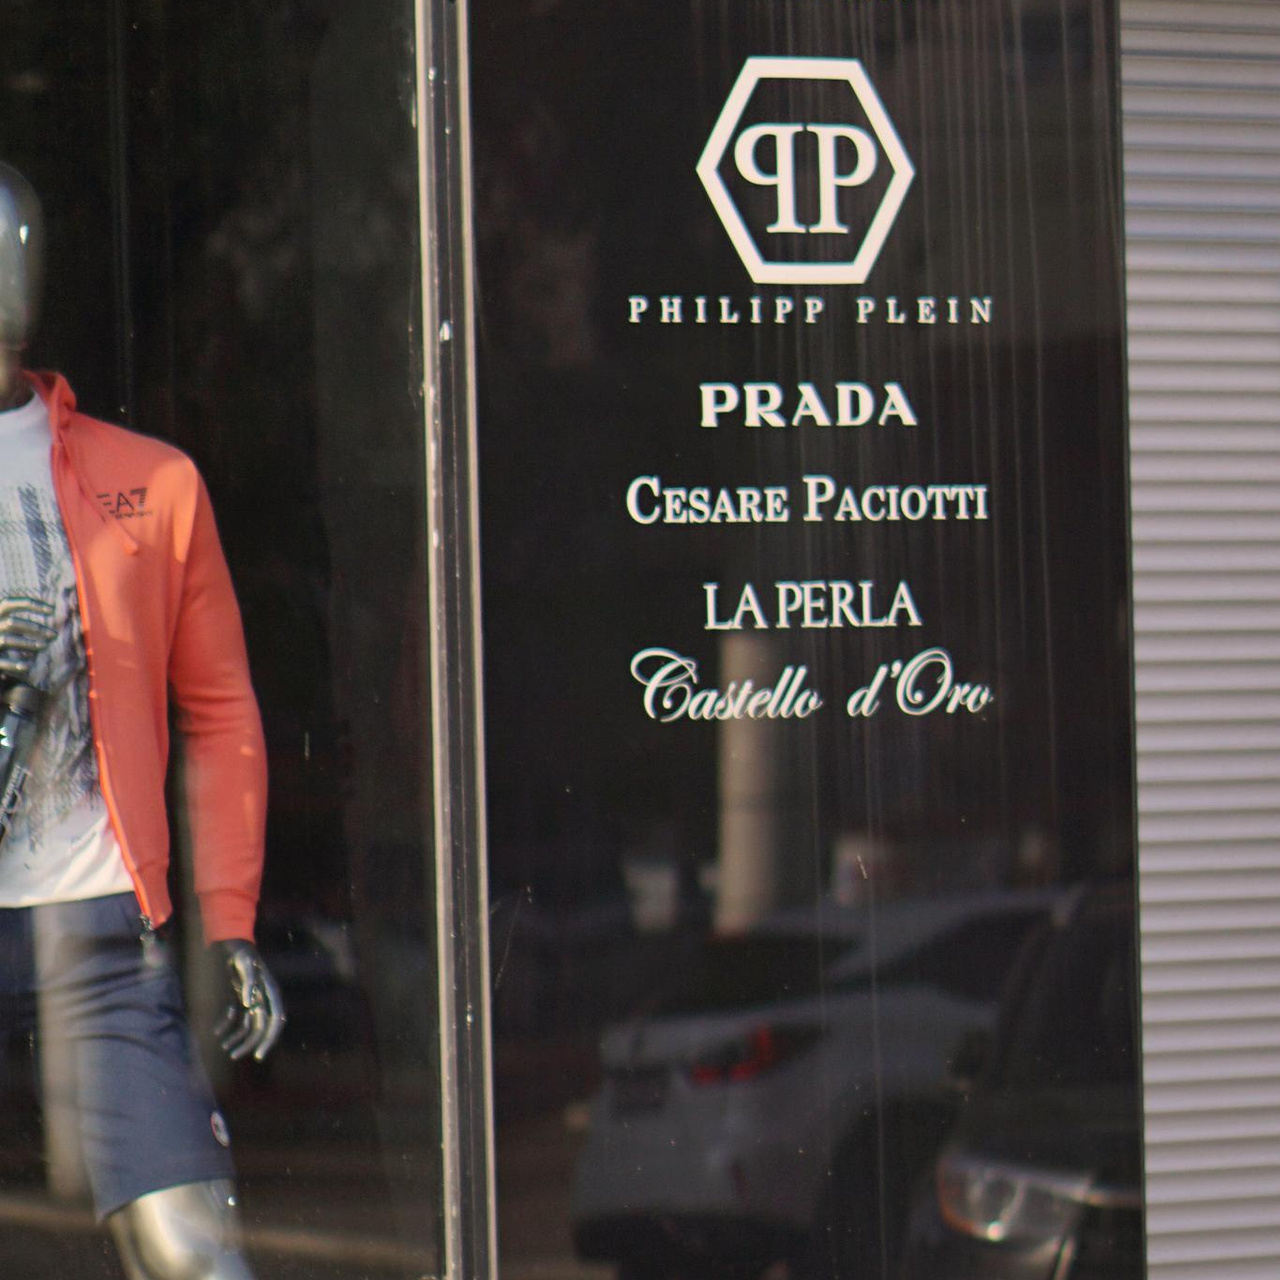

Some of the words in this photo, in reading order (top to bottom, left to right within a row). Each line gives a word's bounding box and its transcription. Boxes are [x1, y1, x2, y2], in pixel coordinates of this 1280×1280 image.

[628, 296, 825, 324] PHILIPP
[856, 297, 993, 324] PLEIN
[699, 382, 918, 428] PRADA
[630, 648, 824, 723] Castello
[846, 648, 994, 720] d'Oro
